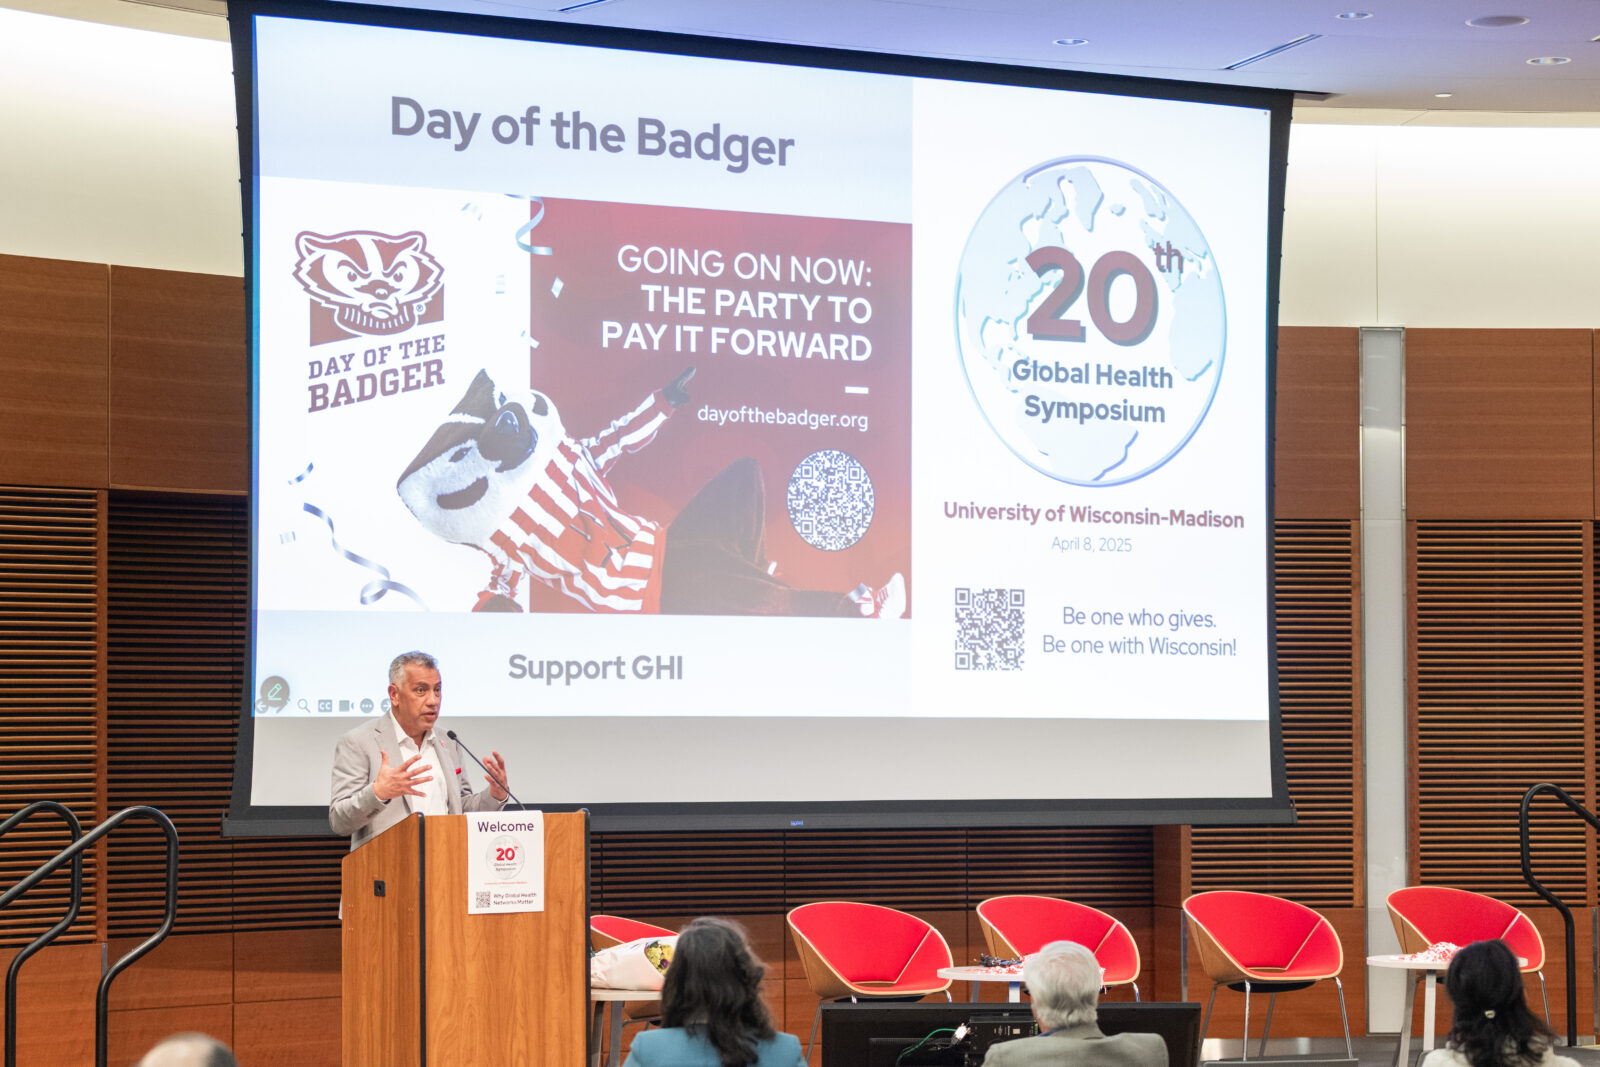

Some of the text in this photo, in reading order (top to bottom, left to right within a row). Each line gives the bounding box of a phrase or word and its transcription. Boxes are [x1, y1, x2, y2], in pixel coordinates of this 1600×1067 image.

[392, 96, 795, 174] Day of the Badger
[617, 244, 872, 287] GOING ON NOW:
[640, 284, 873, 324] THE PARTY TO
[1025, 241, 1183, 347] 20th
[308, 334, 446, 380] DAY OF THE
[602, 321, 873, 362] PAY IT FORWARD
[308, 359, 446, 414] BADGER
[1012, 359, 1174, 389] Global Health
[697, 404, 869, 432] dayofthebadger.org
[1024, 395, 1166, 425] Symposium
[944, 501, 1245, 529] University of Wisconsin-Madison
[1051, 536, 1133, 553] April 8, 2025
[1063, 606, 1217, 632] Be one who gives.
[1043, 635, 1237, 657] Be one with Wisconsin!
[508, 654, 683, 686] Support GHI
[477, 821, 535, 833] Welcome
